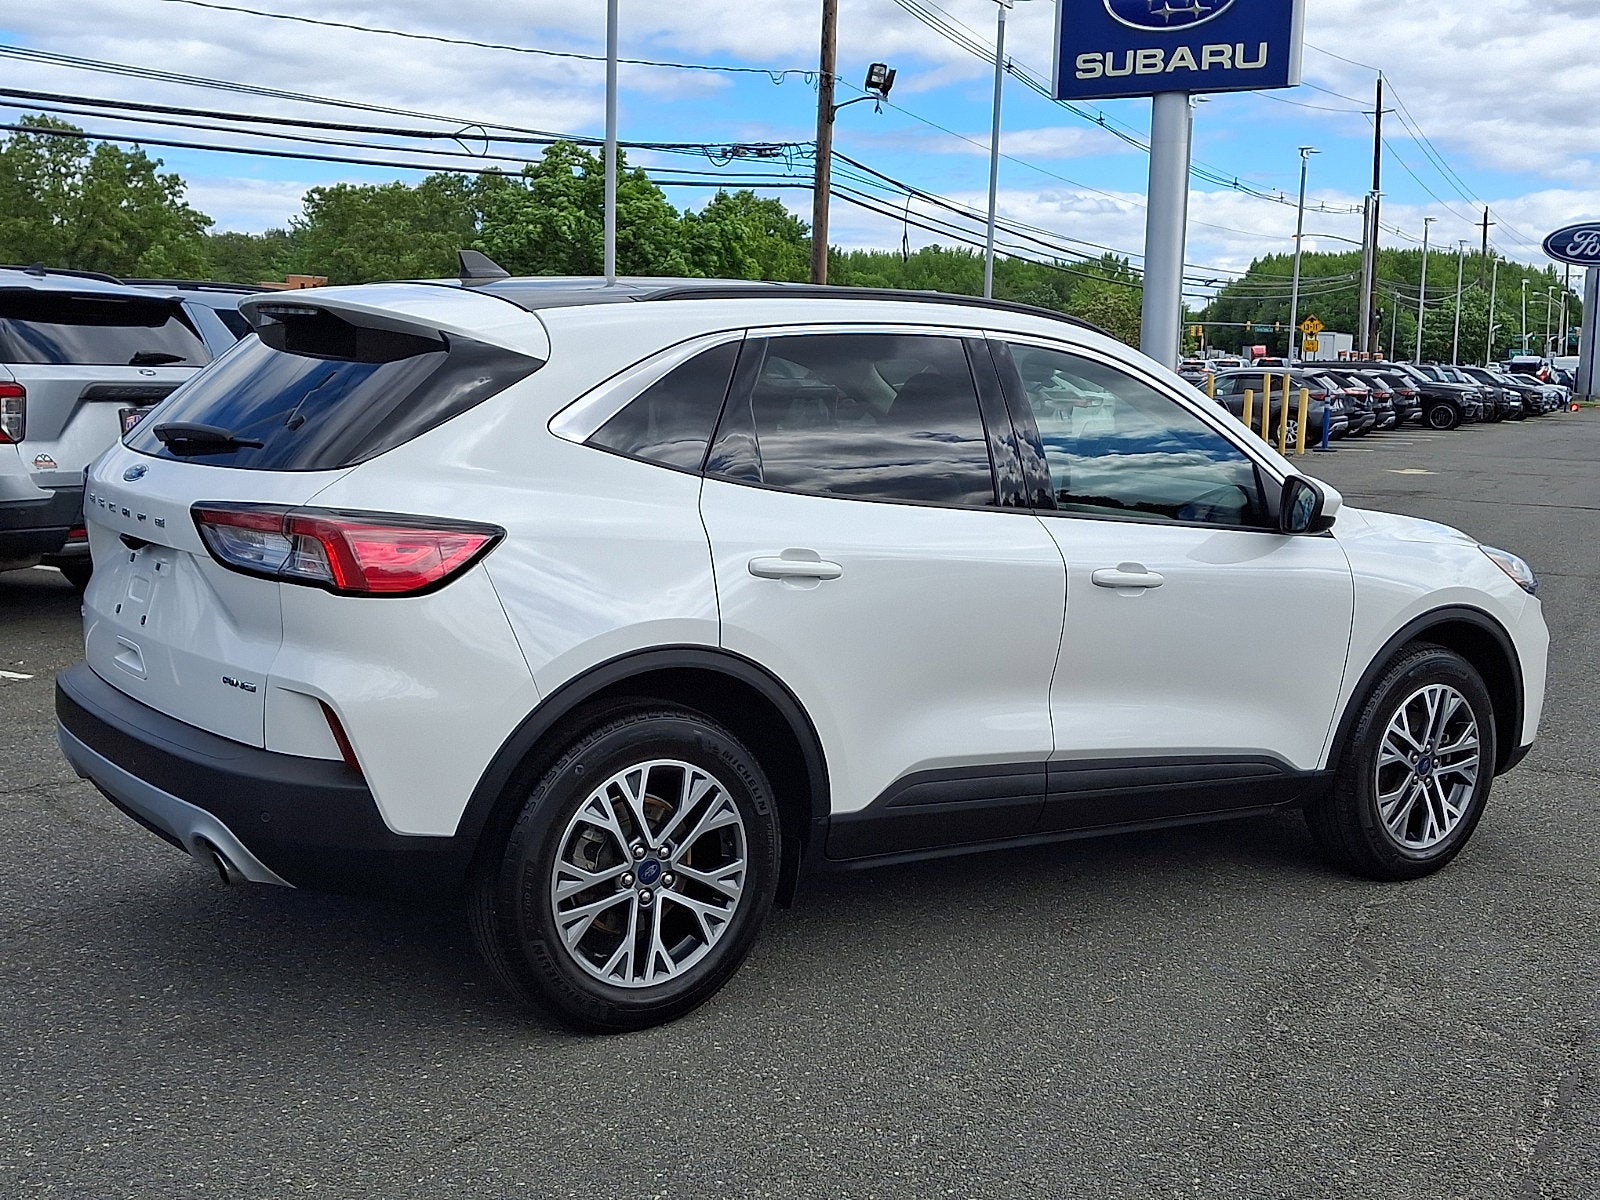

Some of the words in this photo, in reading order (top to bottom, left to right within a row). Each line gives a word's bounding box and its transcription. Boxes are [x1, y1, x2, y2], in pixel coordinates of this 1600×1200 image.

[1075, 42, 1268, 80] SUBARU
[1566, 230, 1600, 256] Fo
[721, 749, 769, 812] MICHELIN
